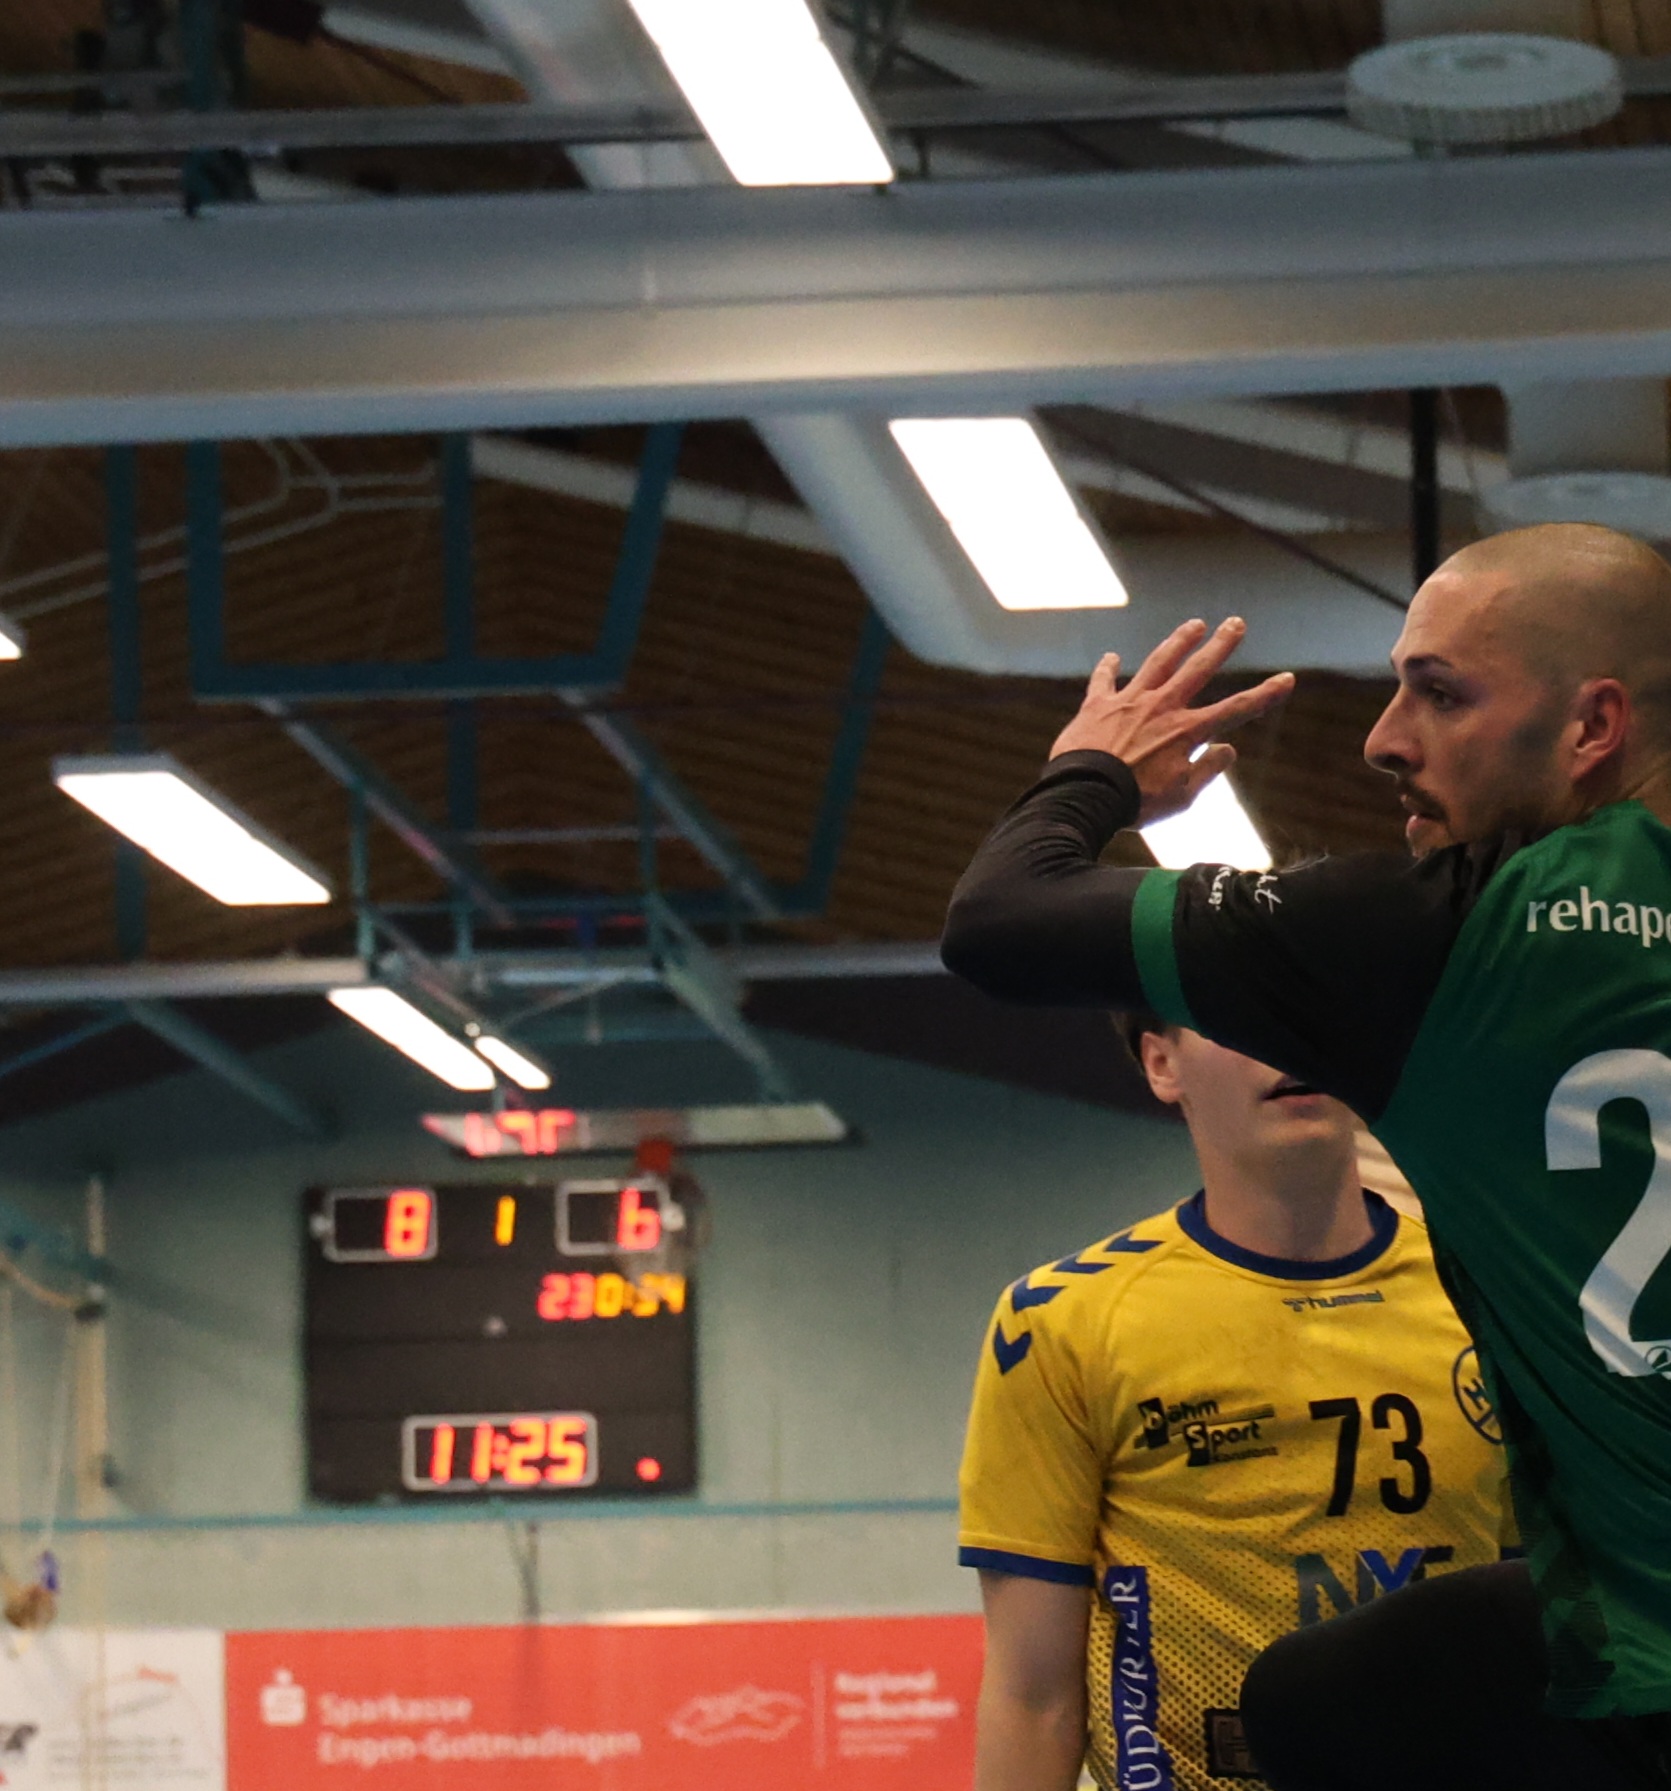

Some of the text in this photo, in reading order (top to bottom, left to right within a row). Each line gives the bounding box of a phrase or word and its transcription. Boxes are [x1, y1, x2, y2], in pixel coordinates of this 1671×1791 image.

[384, 1190, 431, 1258] 8
[495, 1195, 516, 1246] 1
[617, 1187, 661, 1250] 6
[430, 1416, 587, 1485] 11:25
[1309, 1393, 1432, 1517] 73
[320, 1692, 473, 1728] Sparkasse
[317, 1730, 642, 1769] Engen-Gottmadingen
